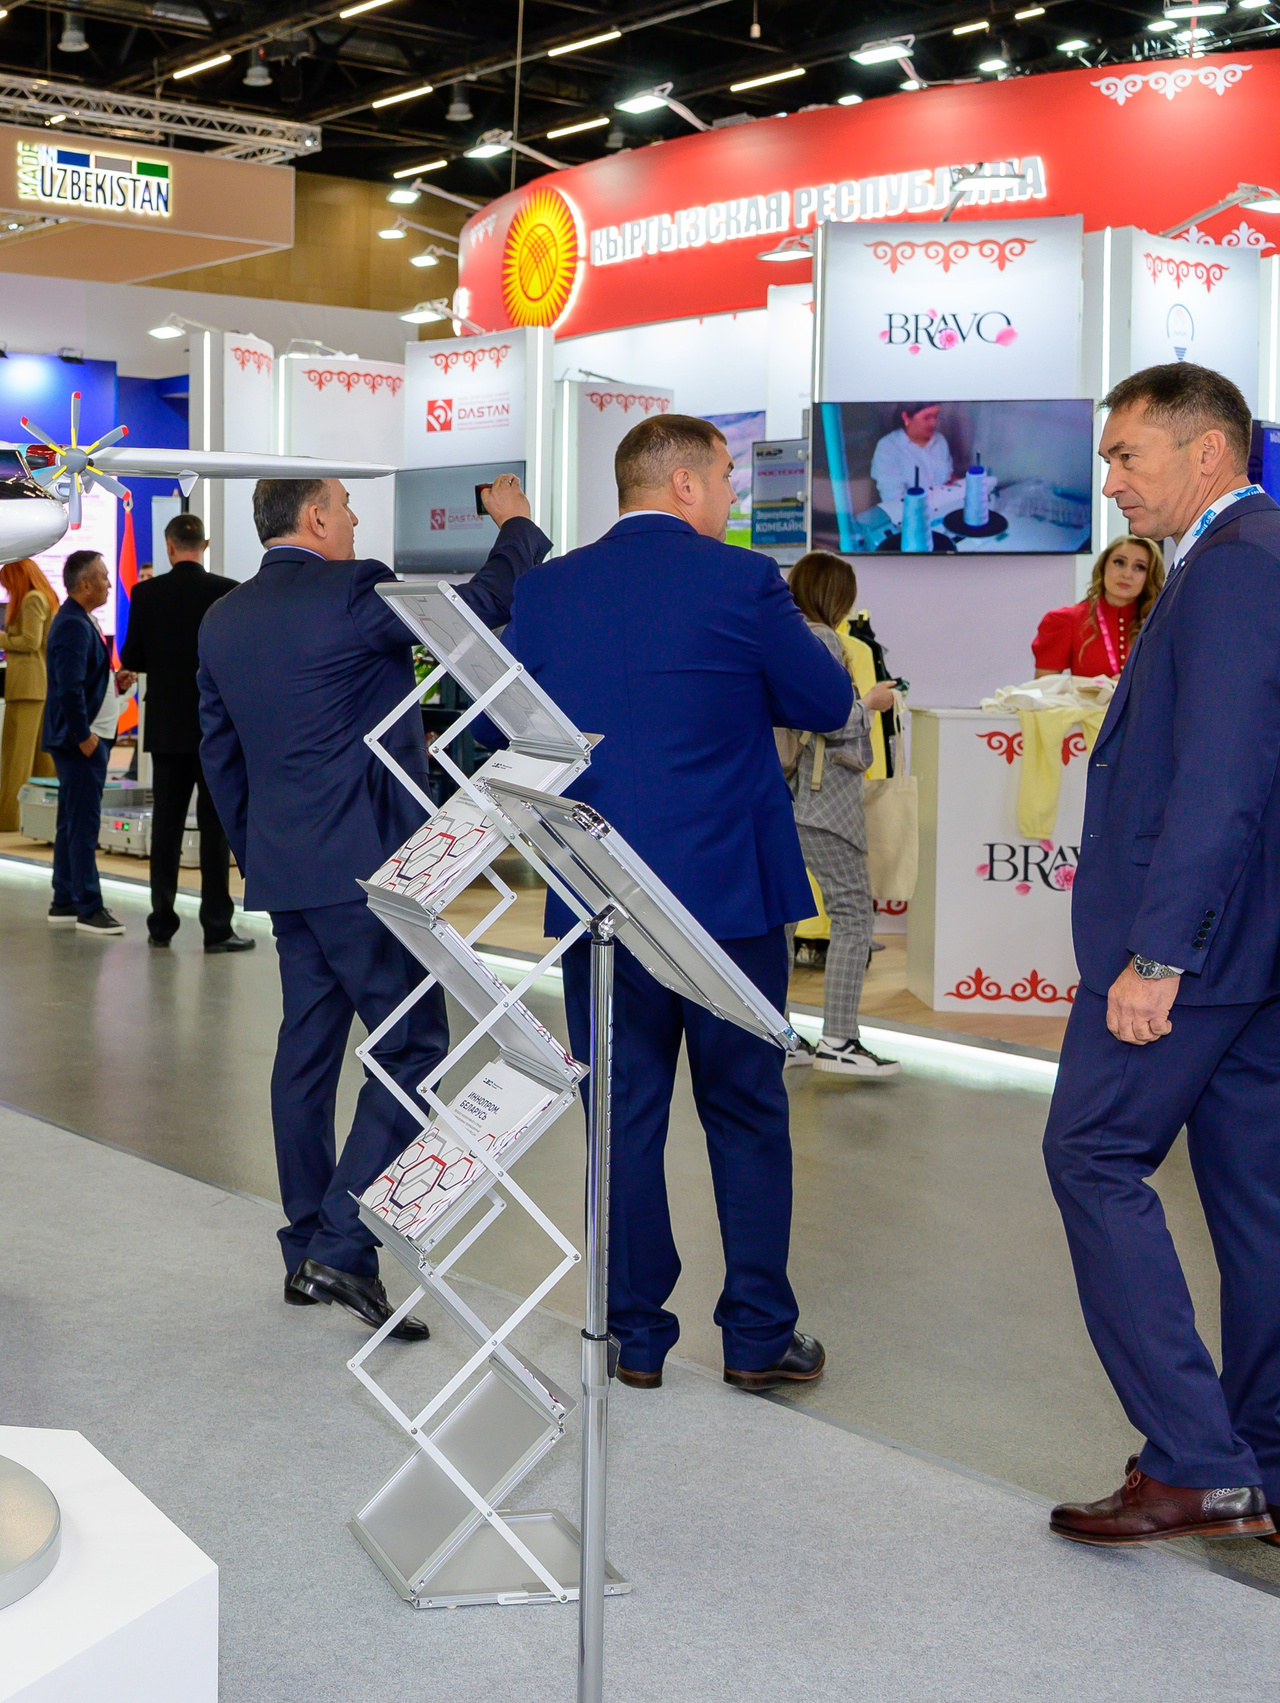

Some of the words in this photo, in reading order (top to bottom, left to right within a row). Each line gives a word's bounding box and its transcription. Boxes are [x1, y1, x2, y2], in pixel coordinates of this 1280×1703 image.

[40, 165, 170, 213] UZBEKISTAN
[590, 191, 789, 266] КЫРГЫЗСКАЯ
[884, 311, 1012, 350] BRAVO
[457, 404, 510, 420] DASTAN
